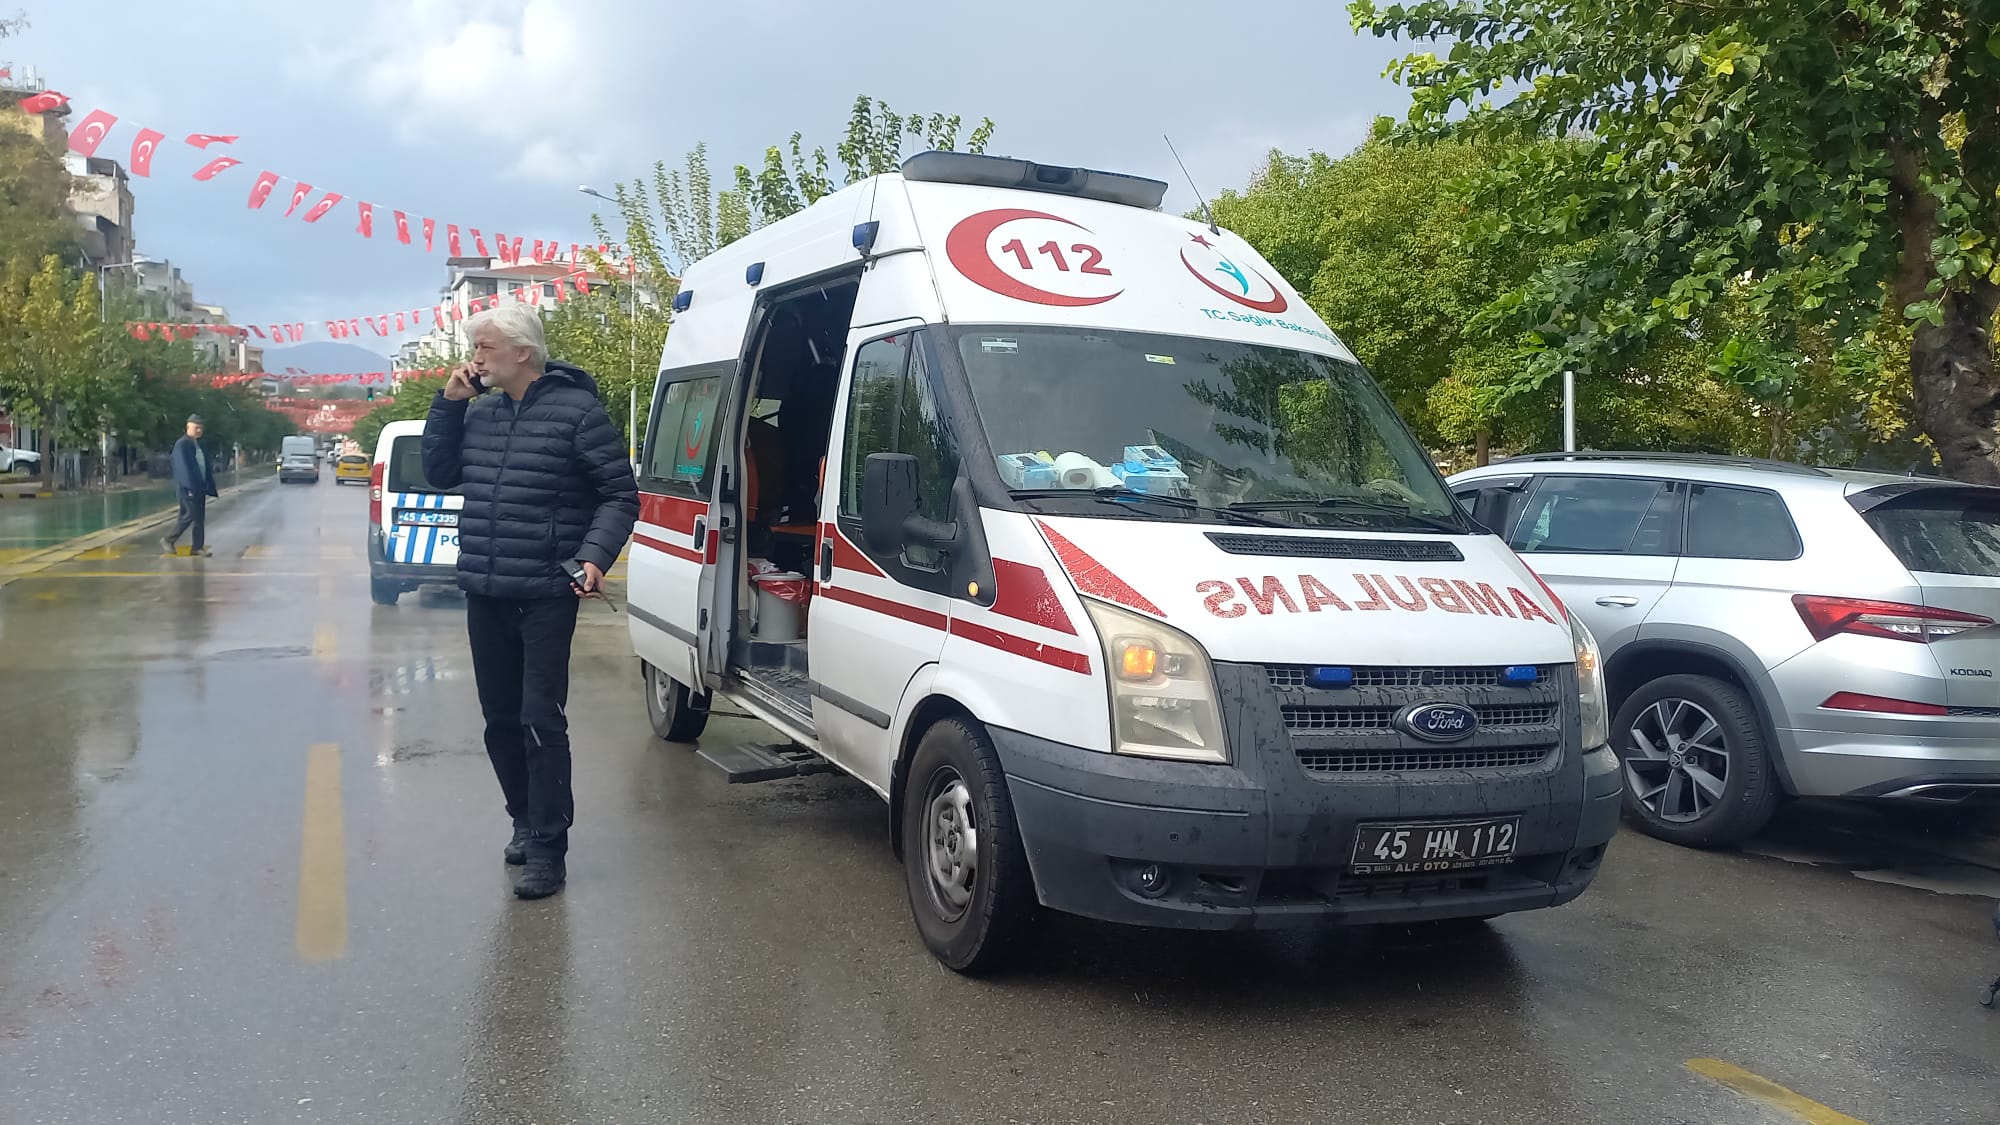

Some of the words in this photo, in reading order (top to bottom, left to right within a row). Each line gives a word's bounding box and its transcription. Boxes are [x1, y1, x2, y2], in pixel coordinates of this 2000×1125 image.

[1001, 239, 1113, 276] 112
[1200, 308, 1229, 320] T.C.
[1228, 311, 1276, 327] Sağlık
[440, 534, 460, 547] PO
[1950, 668, 1993, 678] KODIAQ
[1427, 709, 1465, 730] Ford
[1374, 831, 1411, 860] 45
[1422, 829, 1459, 859] HN
[1471, 823, 1513, 857] 112
[1394, 862, 1421, 873] ALF
[1423, 861, 1450, 872] OTO
